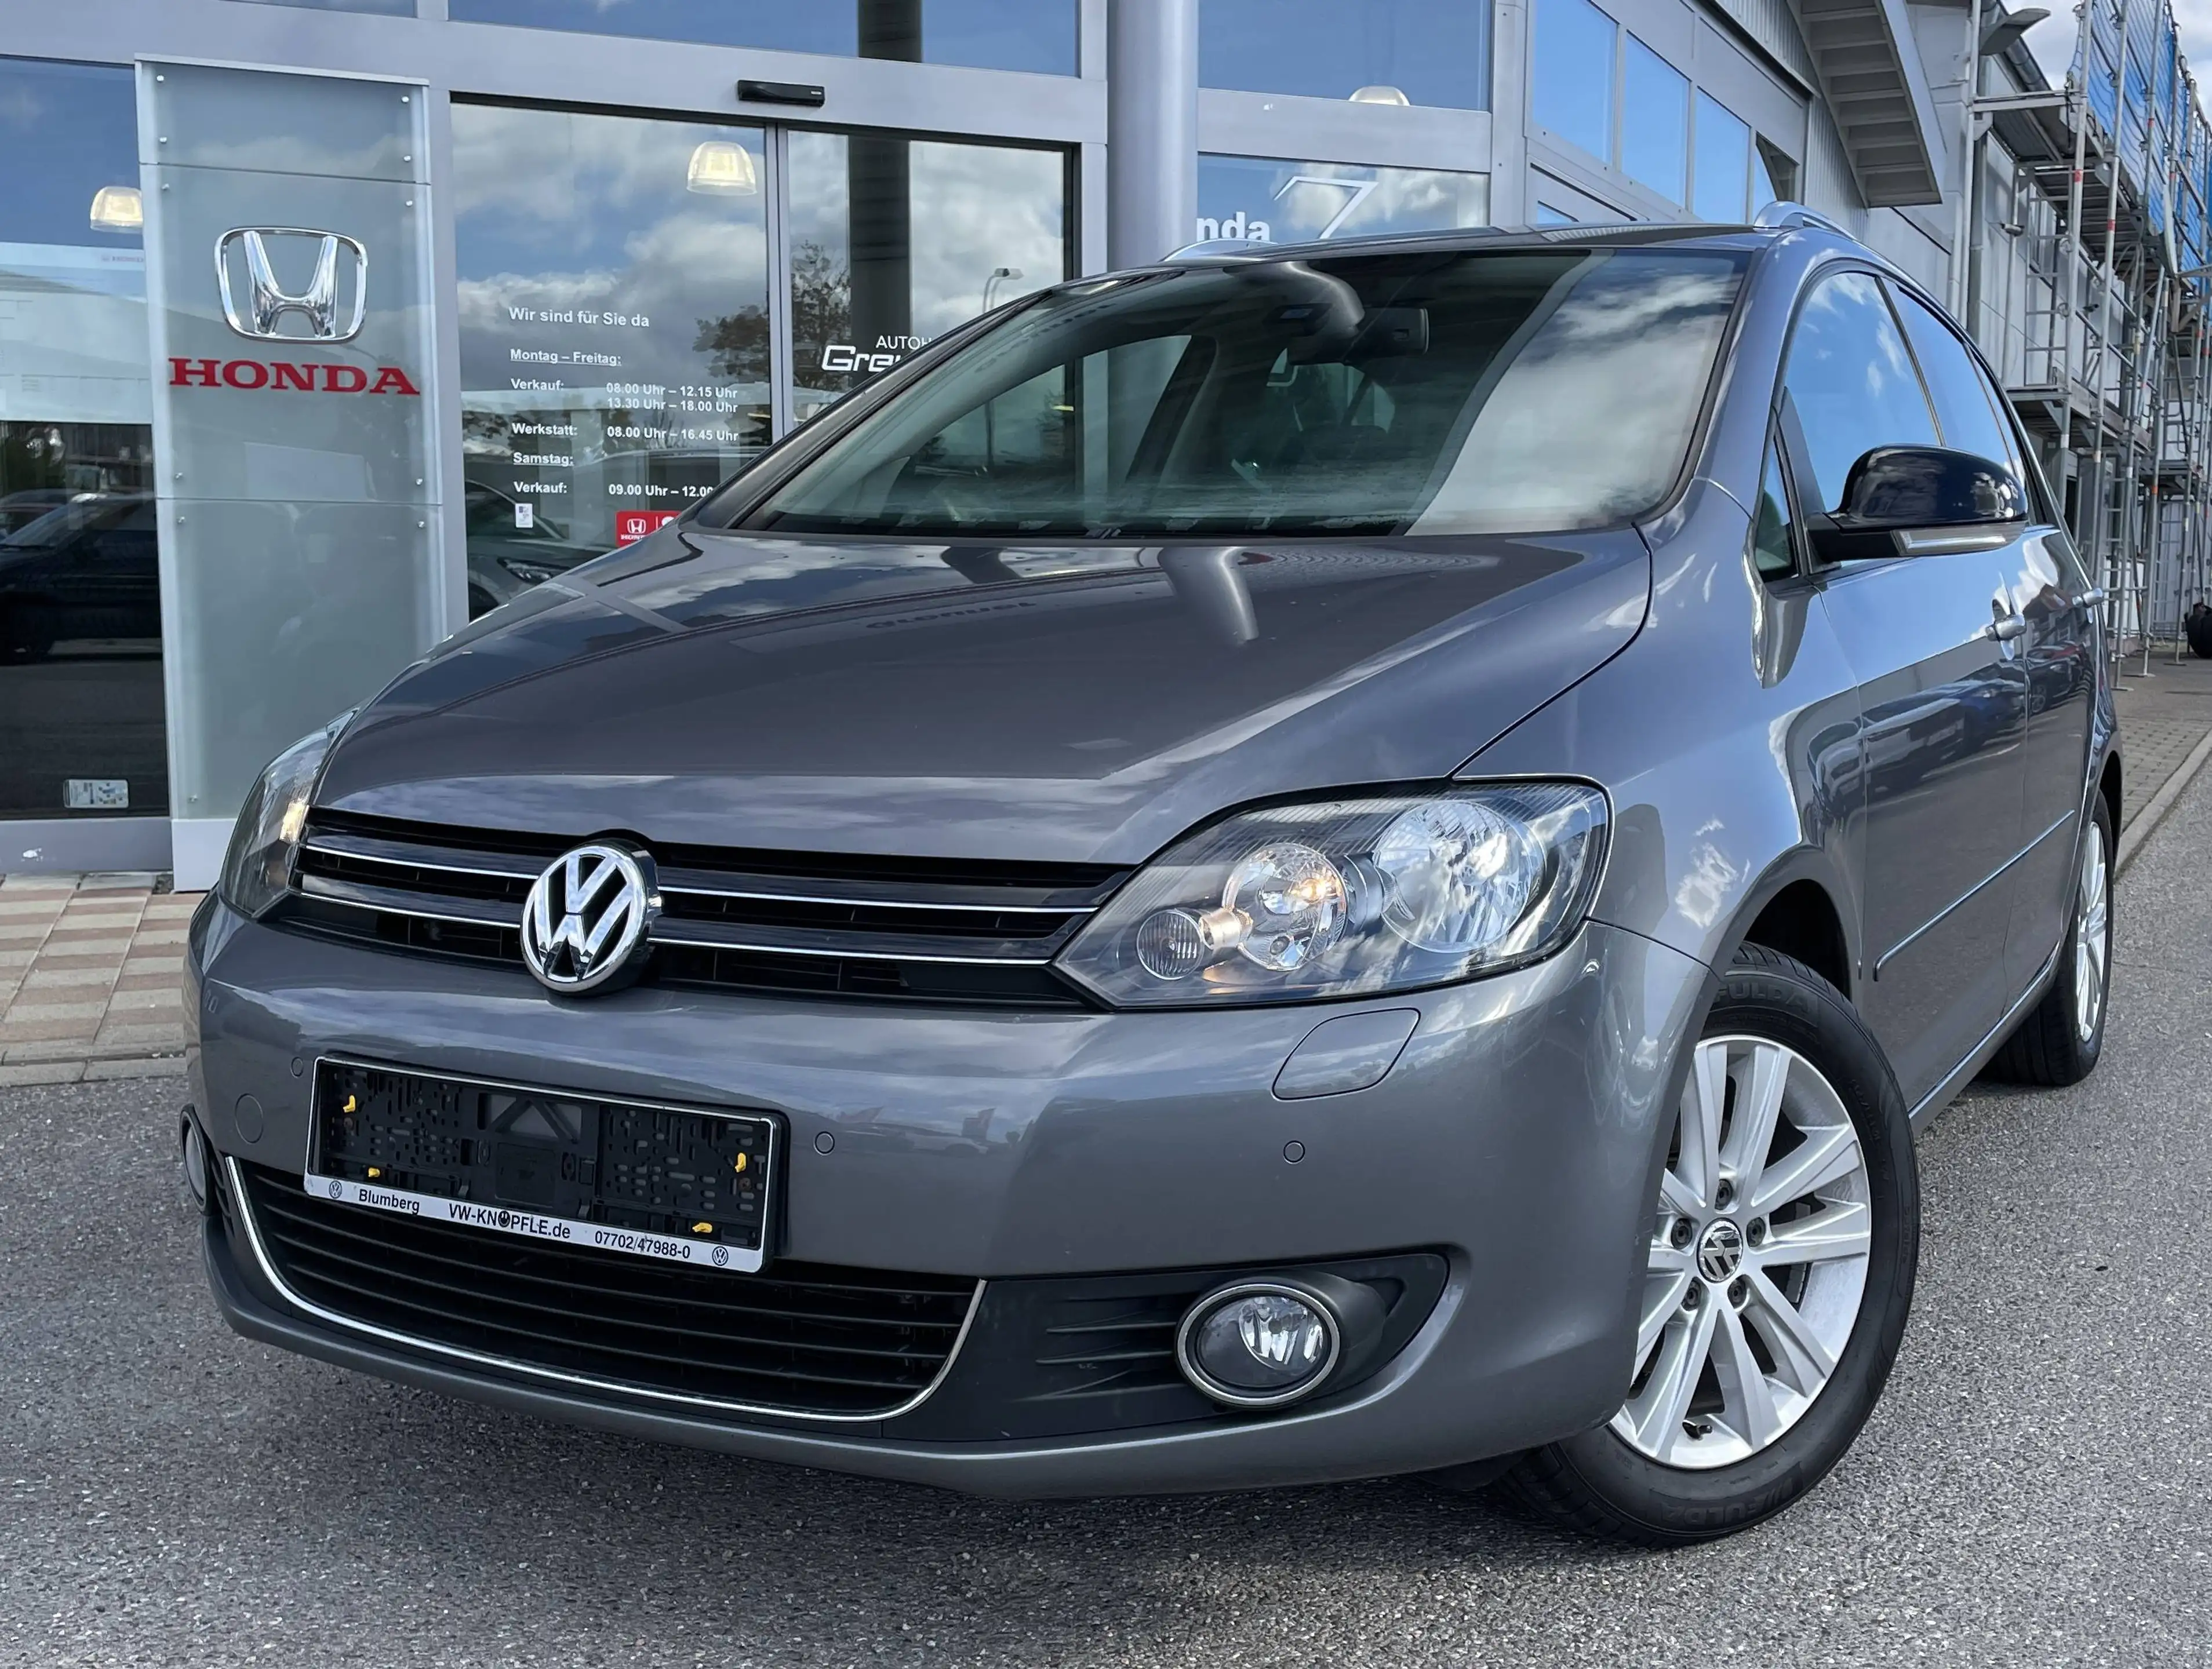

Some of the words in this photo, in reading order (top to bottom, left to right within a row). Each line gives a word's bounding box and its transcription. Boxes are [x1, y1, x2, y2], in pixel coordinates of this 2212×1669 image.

[509, 307, 536, 320] Wir
[540, 309, 573, 323] sind
[577, 310, 599, 325] für
[603, 312, 627, 326] Sie
[631, 314, 650, 327] da
[510, 348, 558, 364] Montag
[573, 351, 622, 366] Freitag:
[169, 358, 420, 395] HONDA
[510, 378, 564, 391] Verkauf:
[606, 382, 638, 394] 08.00
[643, 384, 666, 395] Uhr
[680, 385, 712, 397] 12.15
[715, 387, 738, 399] Uhr
[607, 397, 639, 409] 13.30
[643, 398, 666, 410] Uhr
[680, 400, 712, 411] 18.00
[716, 401, 738, 413] Uhr
[511, 423, 578, 436] Werkstatt:
[607, 426, 640, 438] 08.00
[644, 427, 667, 439] Uhr
[681, 429, 712, 440] 16.45
[716, 430, 738, 442] Uhr
[512, 451, 574, 467] Samstag:
[513, 481, 567, 494] Verkauf:
[609, 484, 642, 495] 09.00
[645, 485, 668, 497] Uhr
[359, 1189, 420, 1215] Blumberg
[595, 1231, 690, 1259] 07702/47988-0
